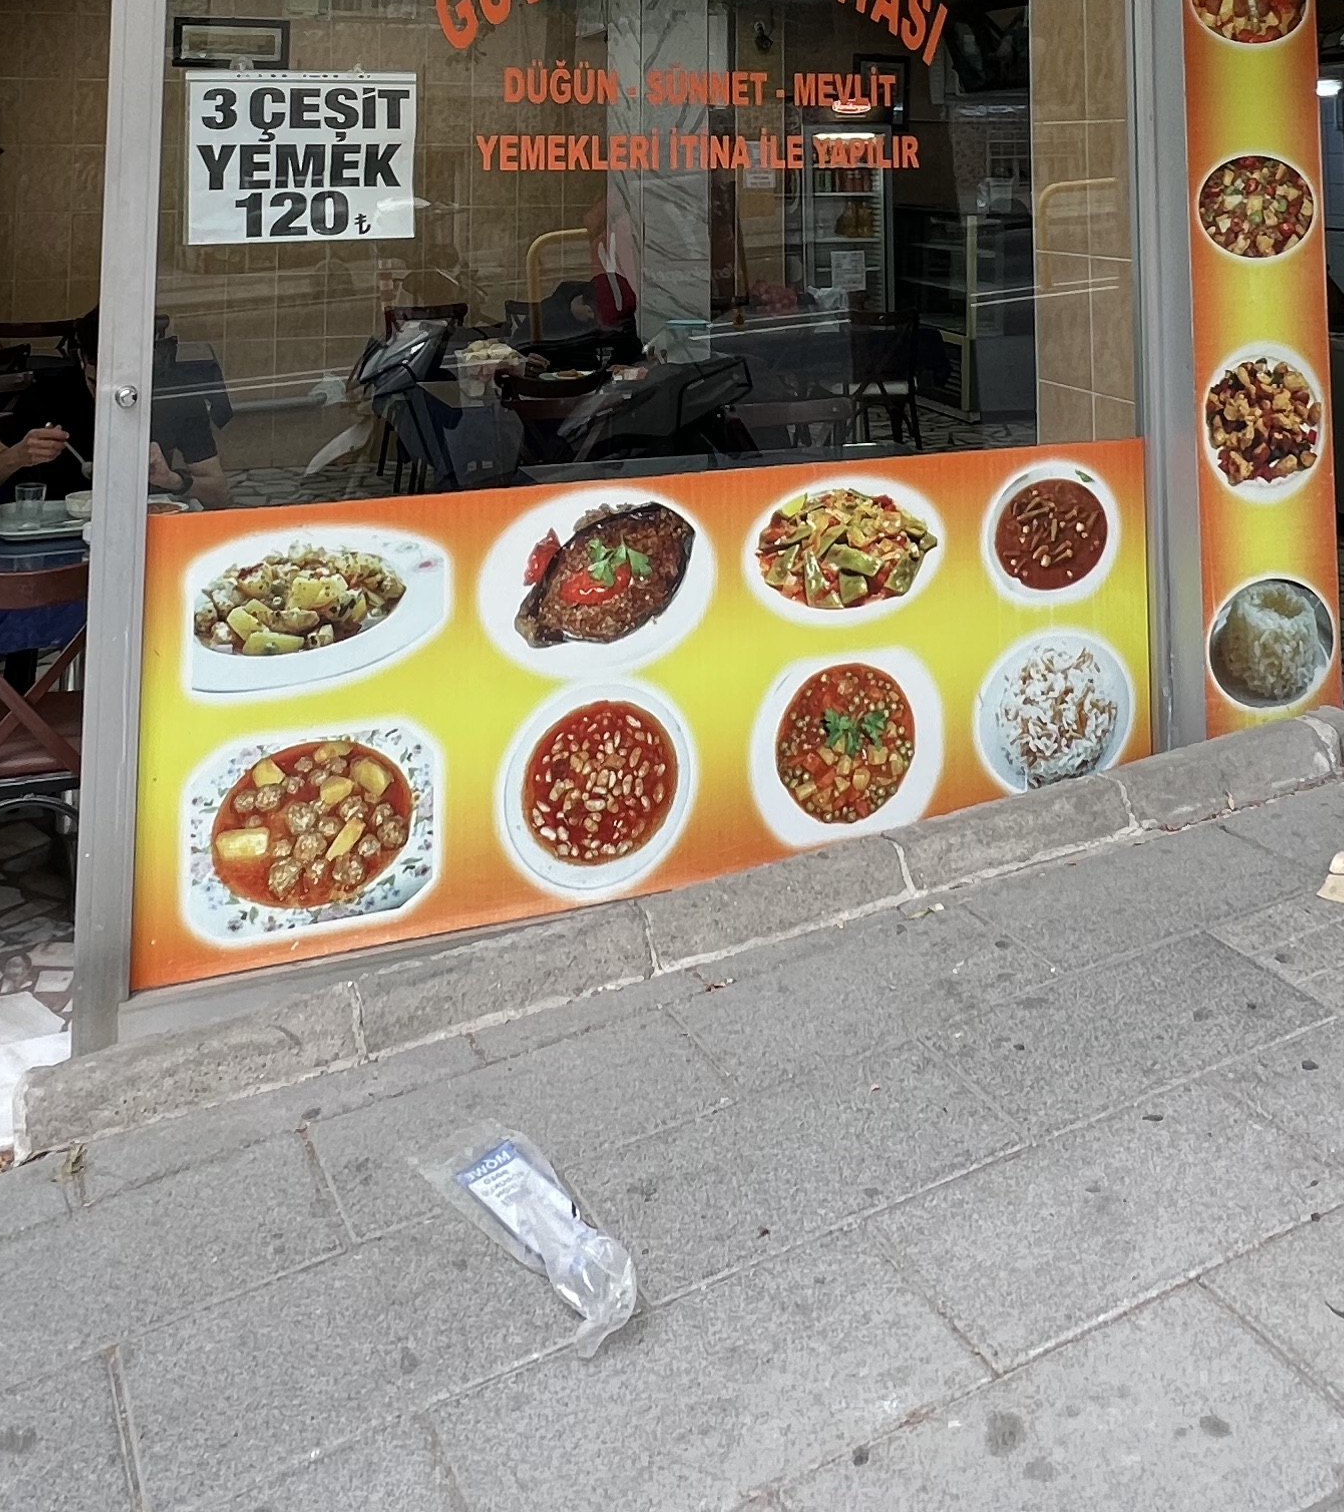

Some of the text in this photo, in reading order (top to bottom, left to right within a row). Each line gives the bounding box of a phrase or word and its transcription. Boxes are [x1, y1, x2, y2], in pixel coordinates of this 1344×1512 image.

[503, 58, 619, 105] DÜĞÜN
[646, 62, 769, 107] SÜNNET
[793, 65, 896, 108] MEVLİT
[201, 87, 238, 130] 3
[197, 143, 402, 191] YEMEK
[476, 127, 920, 171] YEMEKLERİ İTİNA İLE YAPILIR
